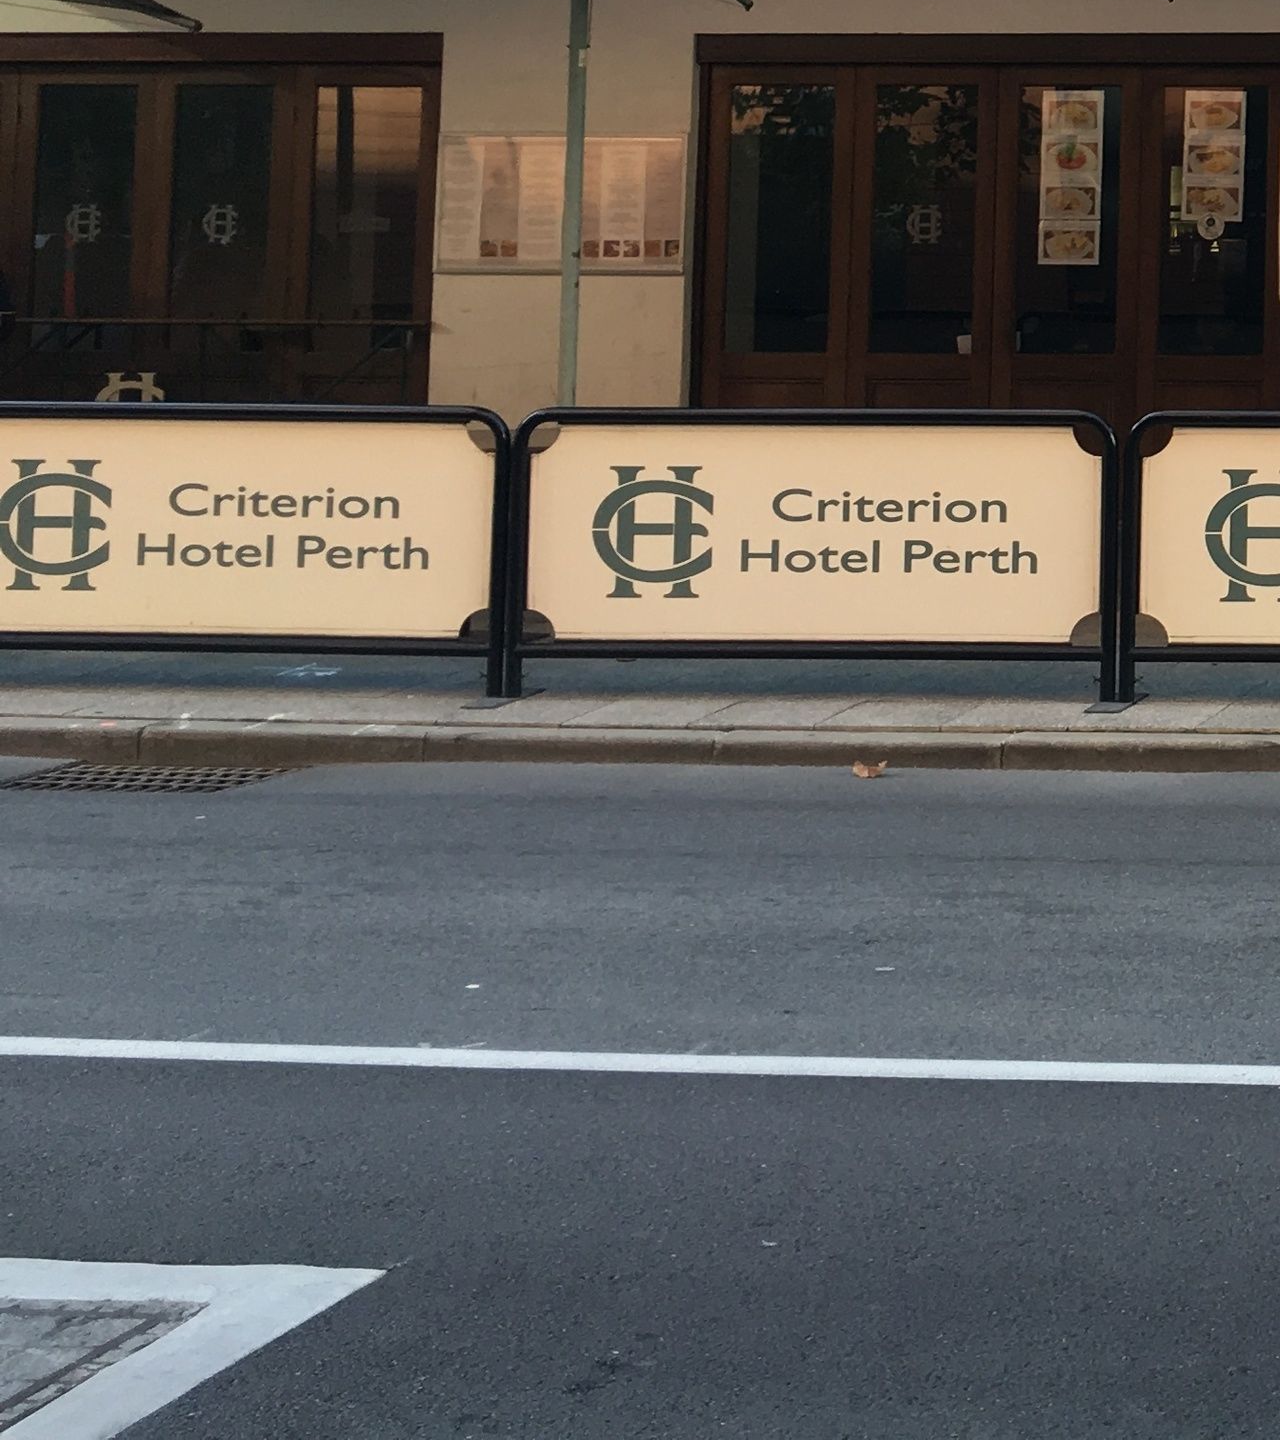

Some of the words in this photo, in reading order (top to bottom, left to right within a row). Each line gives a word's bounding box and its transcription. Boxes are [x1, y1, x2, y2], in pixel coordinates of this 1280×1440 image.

[170, 483, 400, 520] Criterion
[772, 488, 1007, 524] Criterion
[137, 533, 274, 568] Hotel
[297, 536, 429, 570] Perth
[740, 539, 881, 574] Hotel
[903, 540, 1038, 575] Perth
